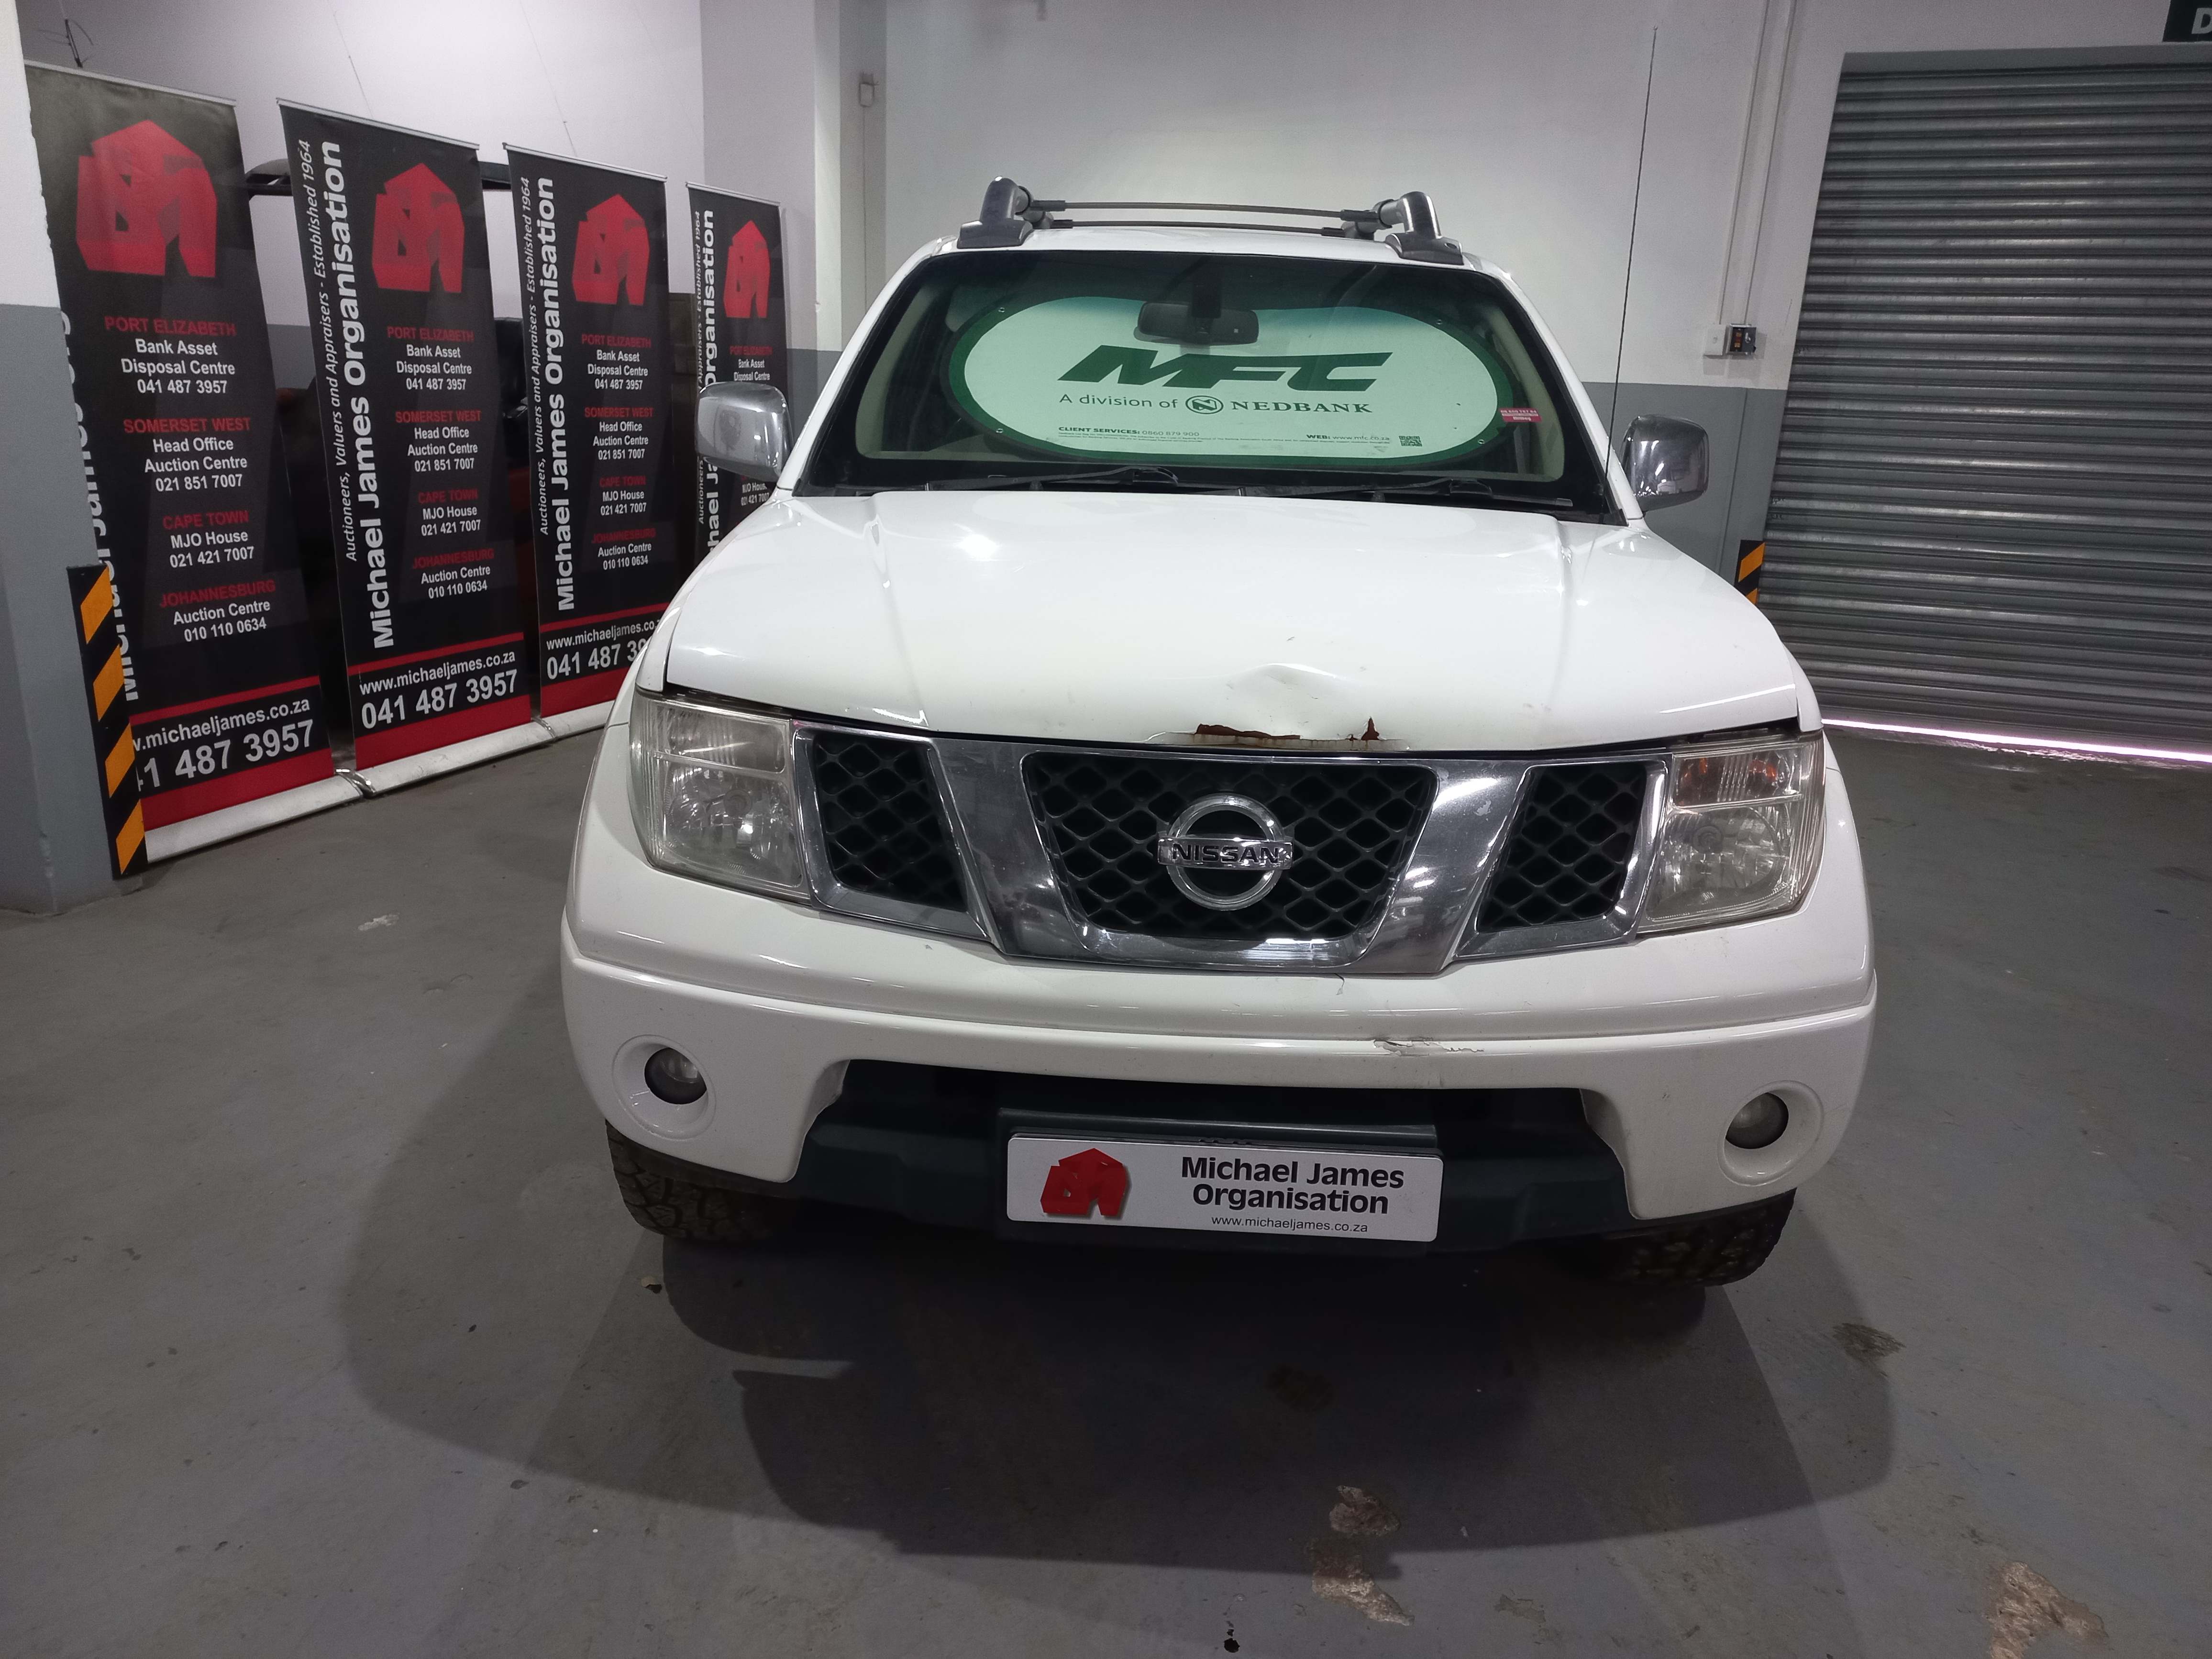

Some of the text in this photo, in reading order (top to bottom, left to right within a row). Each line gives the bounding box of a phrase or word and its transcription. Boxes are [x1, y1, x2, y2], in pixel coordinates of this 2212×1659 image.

[299, 139, 314, 180] 1964
[303, 184, 326, 279] Established
[105, 315, 237, 336] PORT ELIZABETH
[320, 291, 338, 375] Appraisers
[387, 326, 475, 342] PORT ELIZABETH
[135, 339, 218, 355] Bank Asset
[582, 334, 605, 345] PORT
[406, 344, 461, 358] Bank Asset
[520, 177, 549, 535] Auctioneers, Valuers and Appraisers Established 1964
[597, 349, 640, 362] Bank Asset
[121, 358, 235, 376] Disposal Centre
[396, 361, 472, 376] Disposal Centre
[587, 364, 648, 377] Disposal Centre
[738, 358, 765, 368] Bank Asset
[1057, 345, 1393, 392] MFC
[406, 378, 466, 390] 041 487 3957
[595, 378, 643, 390] 041 487 3957
[733, 371, 770, 381] Disposal Centre
[137, 379, 227, 393] 041 487 3957
[326, 376, 340, 407] and
[537, 178, 575, 611] Michael James Organisation
[321, 141, 394, 649] Michael James Organisation
[1059, 394, 1179, 409] A division of
[632, 407, 653, 418] WEST
[1231, 400, 1373, 414] NEDBANK
[123, 417, 250, 433] SOMERSET WEST
[395, 410, 481, 423] SOMERSET WEST
[414, 426, 469, 439] Head Office
[599, 421, 642, 432] Head Office
[153, 437, 233, 453] Head Office
[333, 411, 346, 466] Valuers
[593, 435, 649, 446] Auction Centre
[407, 442, 478, 456] Auction Centre
[598, 449, 645, 460] 021 851 7007
[144, 456, 247, 473] Auction Centre
[414, 458, 475, 472] 021 851 7007
[155, 474, 243, 492] 021 851 7007
[418, 488, 478, 503] CAPE TOWN
[602, 490, 644, 502] MJO House
[339, 471, 358, 561] Auctioneers,
[422, 506, 477, 520] MJO House
[600, 502, 646, 516] 021 421 7007
[163, 510, 249, 530] CAPE TOWN
[421, 519, 481, 536] 021 421 7007
[707, 492, 719, 547] hael
[170, 531, 248, 549] MJO House
[170, 546, 254, 568] 021 421 7007
[598, 542, 652, 557] Auction Centre
[413, 548, 495, 569] JOHANNESBURG
[603, 554, 648, 570] 010 110 0634
[421, 565, 490, 584] Auction Centre
[160, 579, 276, 608] JOHANNESBURG
[428, 580, 487, 599] 010 110 0634
[174, 601, 270, 625] Auction Centre
[184, 617, 266, 642] 010 110 0634
[546, 619, 660, 650] www.michaeljames.co.
[547, 651, 580, 679] 041
[588, 644, 620, 670] 487
[360, 651, 515, 695] www.michaeljames.co.za
[362, 669, 517, 729] 041 487 3957
[175, 739, 231, 779] 487
[243, 719, 313, 762] 3957
[1172, 843, 1281, 864] NISSAN
[1182, 1156, 1405, 1189] Michael James
[1192, 1183, 1389, 1215] Organisation
[1211, 1215, 1369, 1233] www.michaeljames.co.za
